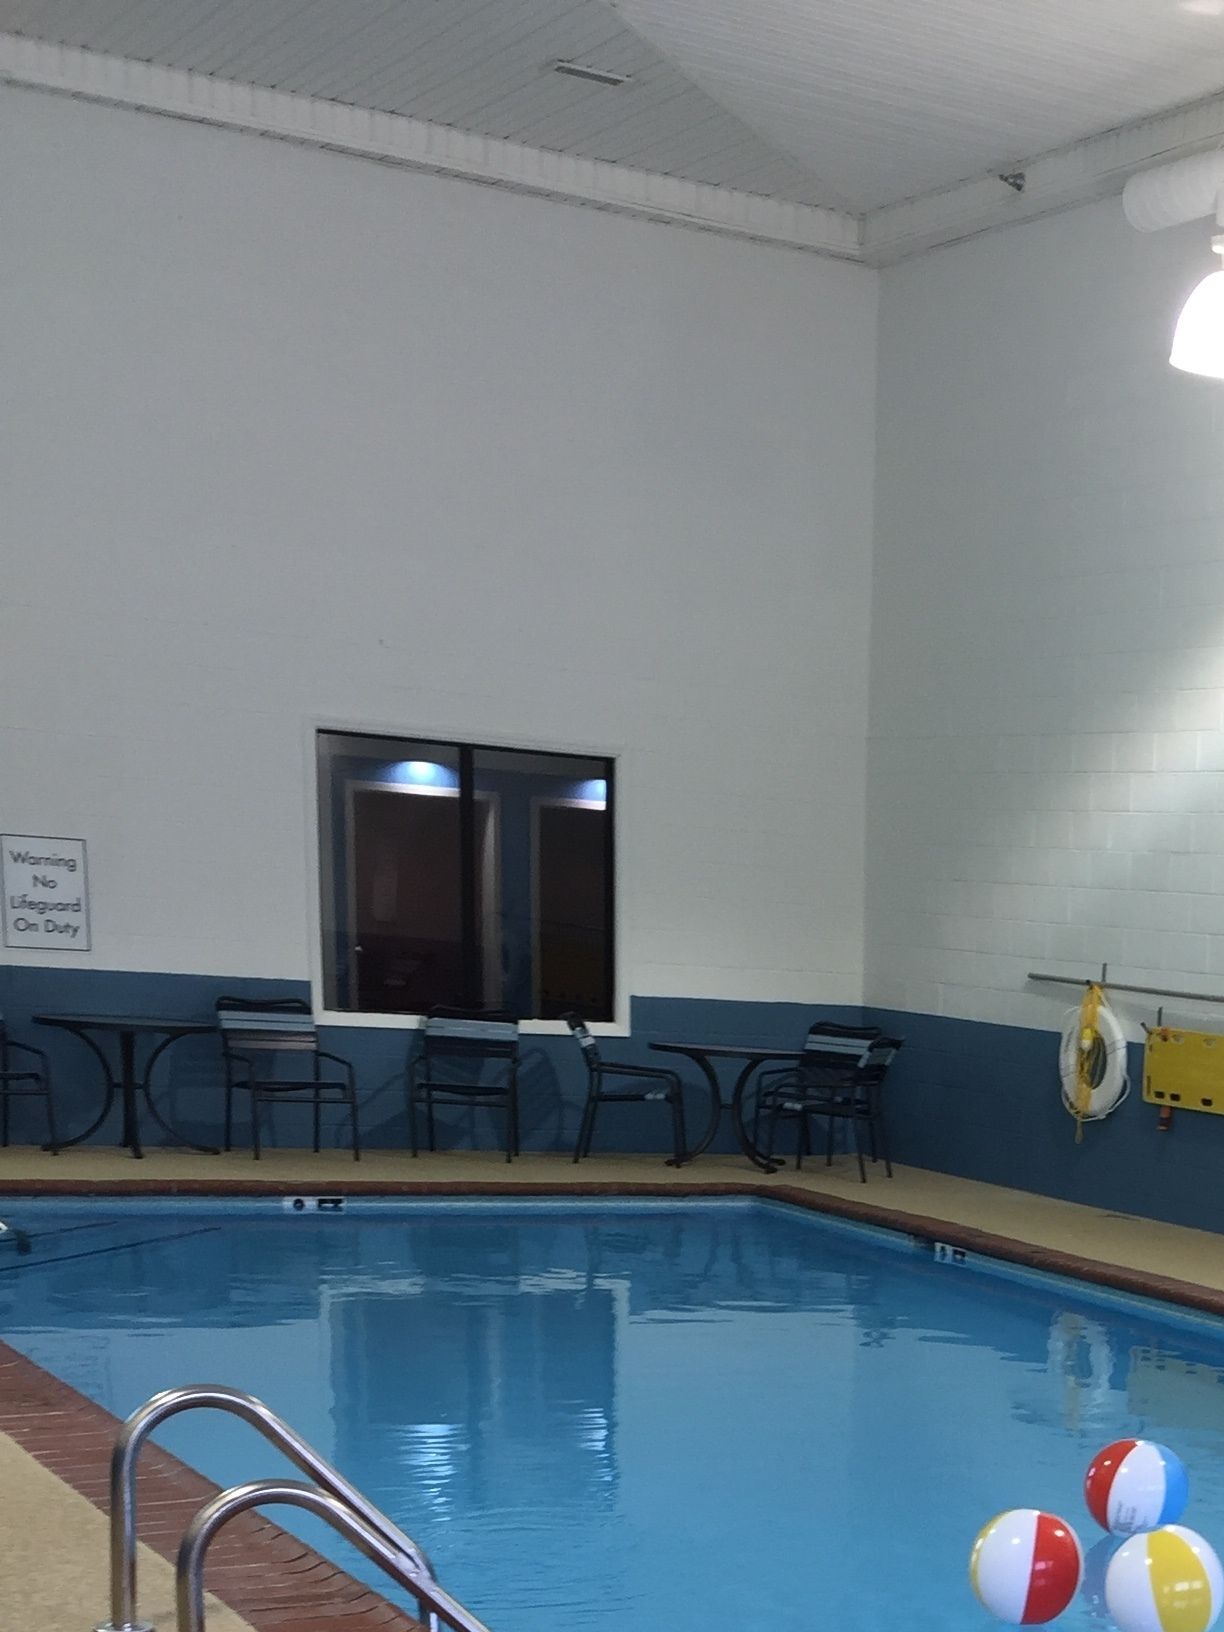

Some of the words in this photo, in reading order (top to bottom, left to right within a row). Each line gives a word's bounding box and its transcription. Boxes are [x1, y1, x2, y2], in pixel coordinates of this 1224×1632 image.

[9, 850, 77, 872] Warning
[32, 874, 58, 889] No
[9, 894, 82, 915] Lifeguard
[13, 917, 39, 932] On
[43, 919, 80, 938] Duty
